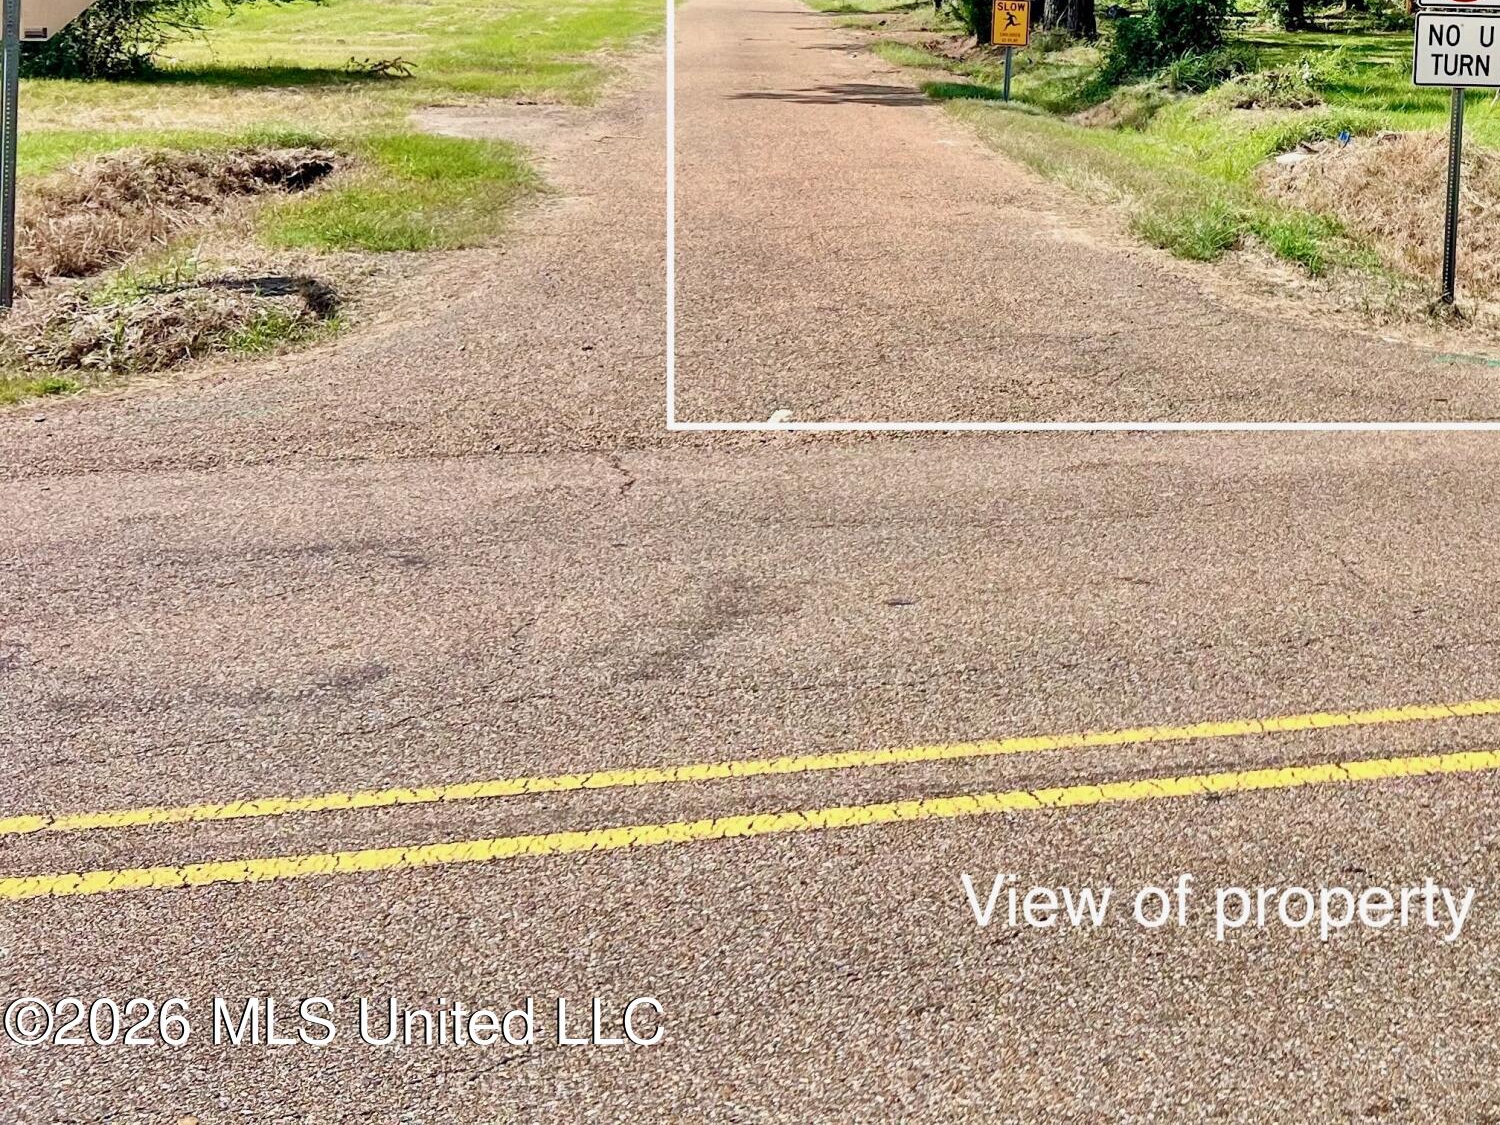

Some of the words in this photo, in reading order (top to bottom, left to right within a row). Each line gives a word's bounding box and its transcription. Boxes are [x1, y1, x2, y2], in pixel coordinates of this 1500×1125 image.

[997, 1, 1025, 12] SLOW
[1428, 24, 1461, 47] NO
[1480, 25, 1495, 48] U
[1431, 53, 1491, 77] TURN
